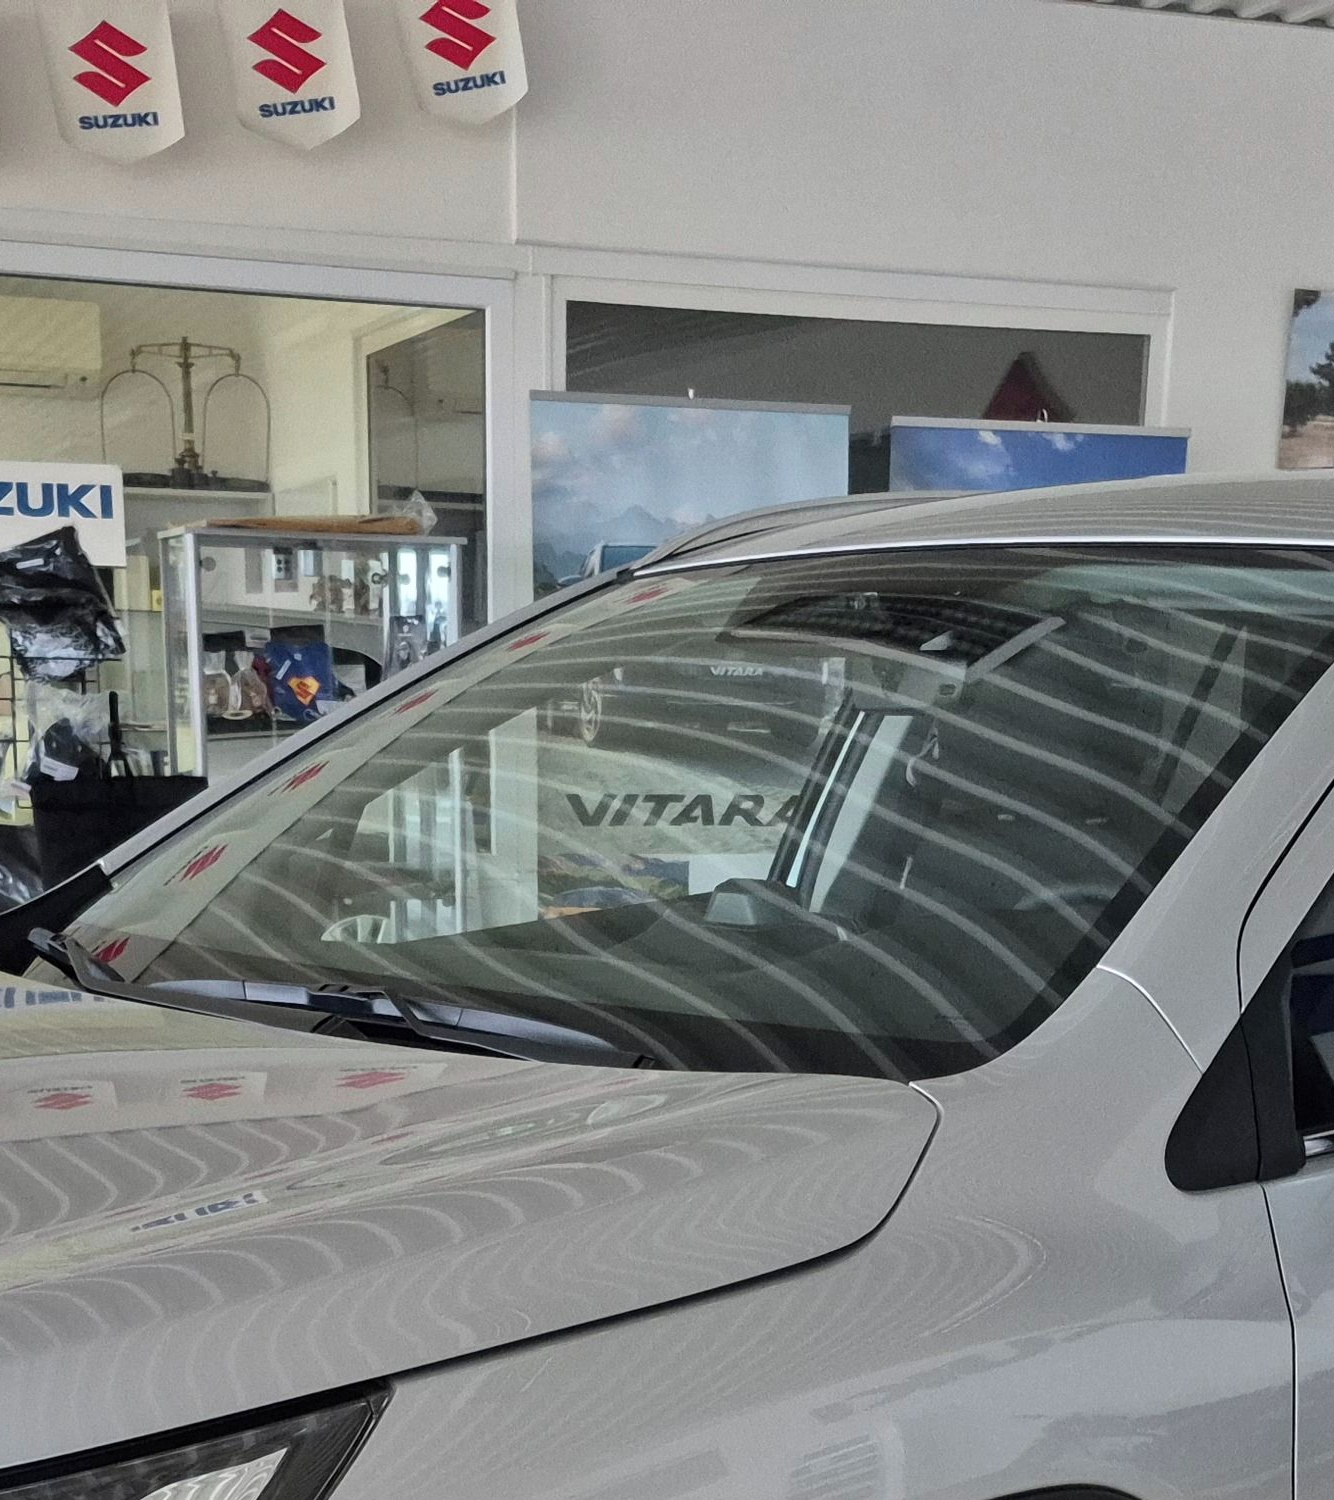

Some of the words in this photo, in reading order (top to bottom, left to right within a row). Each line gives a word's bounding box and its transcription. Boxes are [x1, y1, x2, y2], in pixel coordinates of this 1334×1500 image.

[432, 69, 507, 97] SUZUKI
[258, 95, 337, 120] SUZUKI
[78, 111, 159, 130] SUZUKI
[710, 666, 763, 676] VITARA
